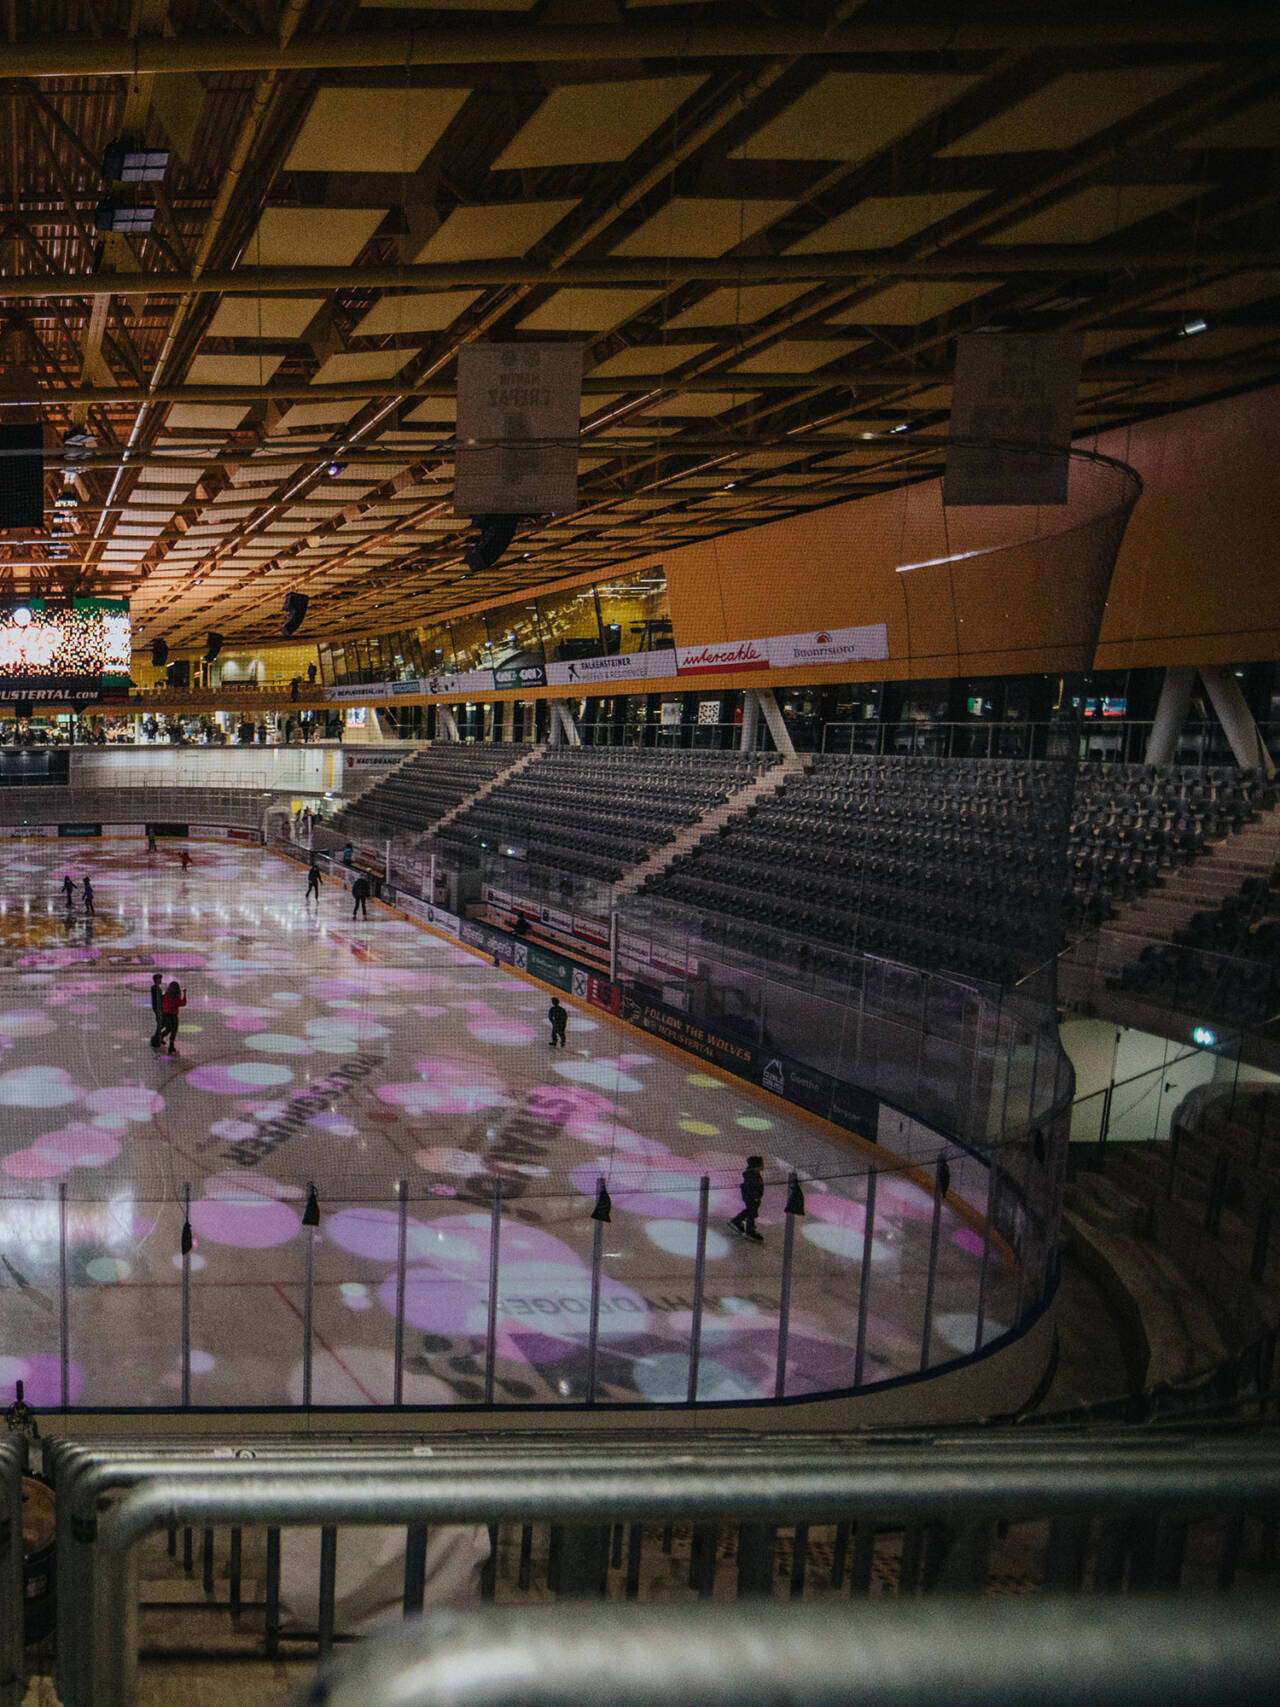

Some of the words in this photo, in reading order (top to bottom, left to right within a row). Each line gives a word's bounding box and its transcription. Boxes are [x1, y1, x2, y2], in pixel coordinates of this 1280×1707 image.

[682, 642, 761, 665] intercable
[644, 1006, 682, 1031] FOLLOW
[684, 1023, 704, 1039] THE
[706, 1034, 752, 1063] WOLVES
